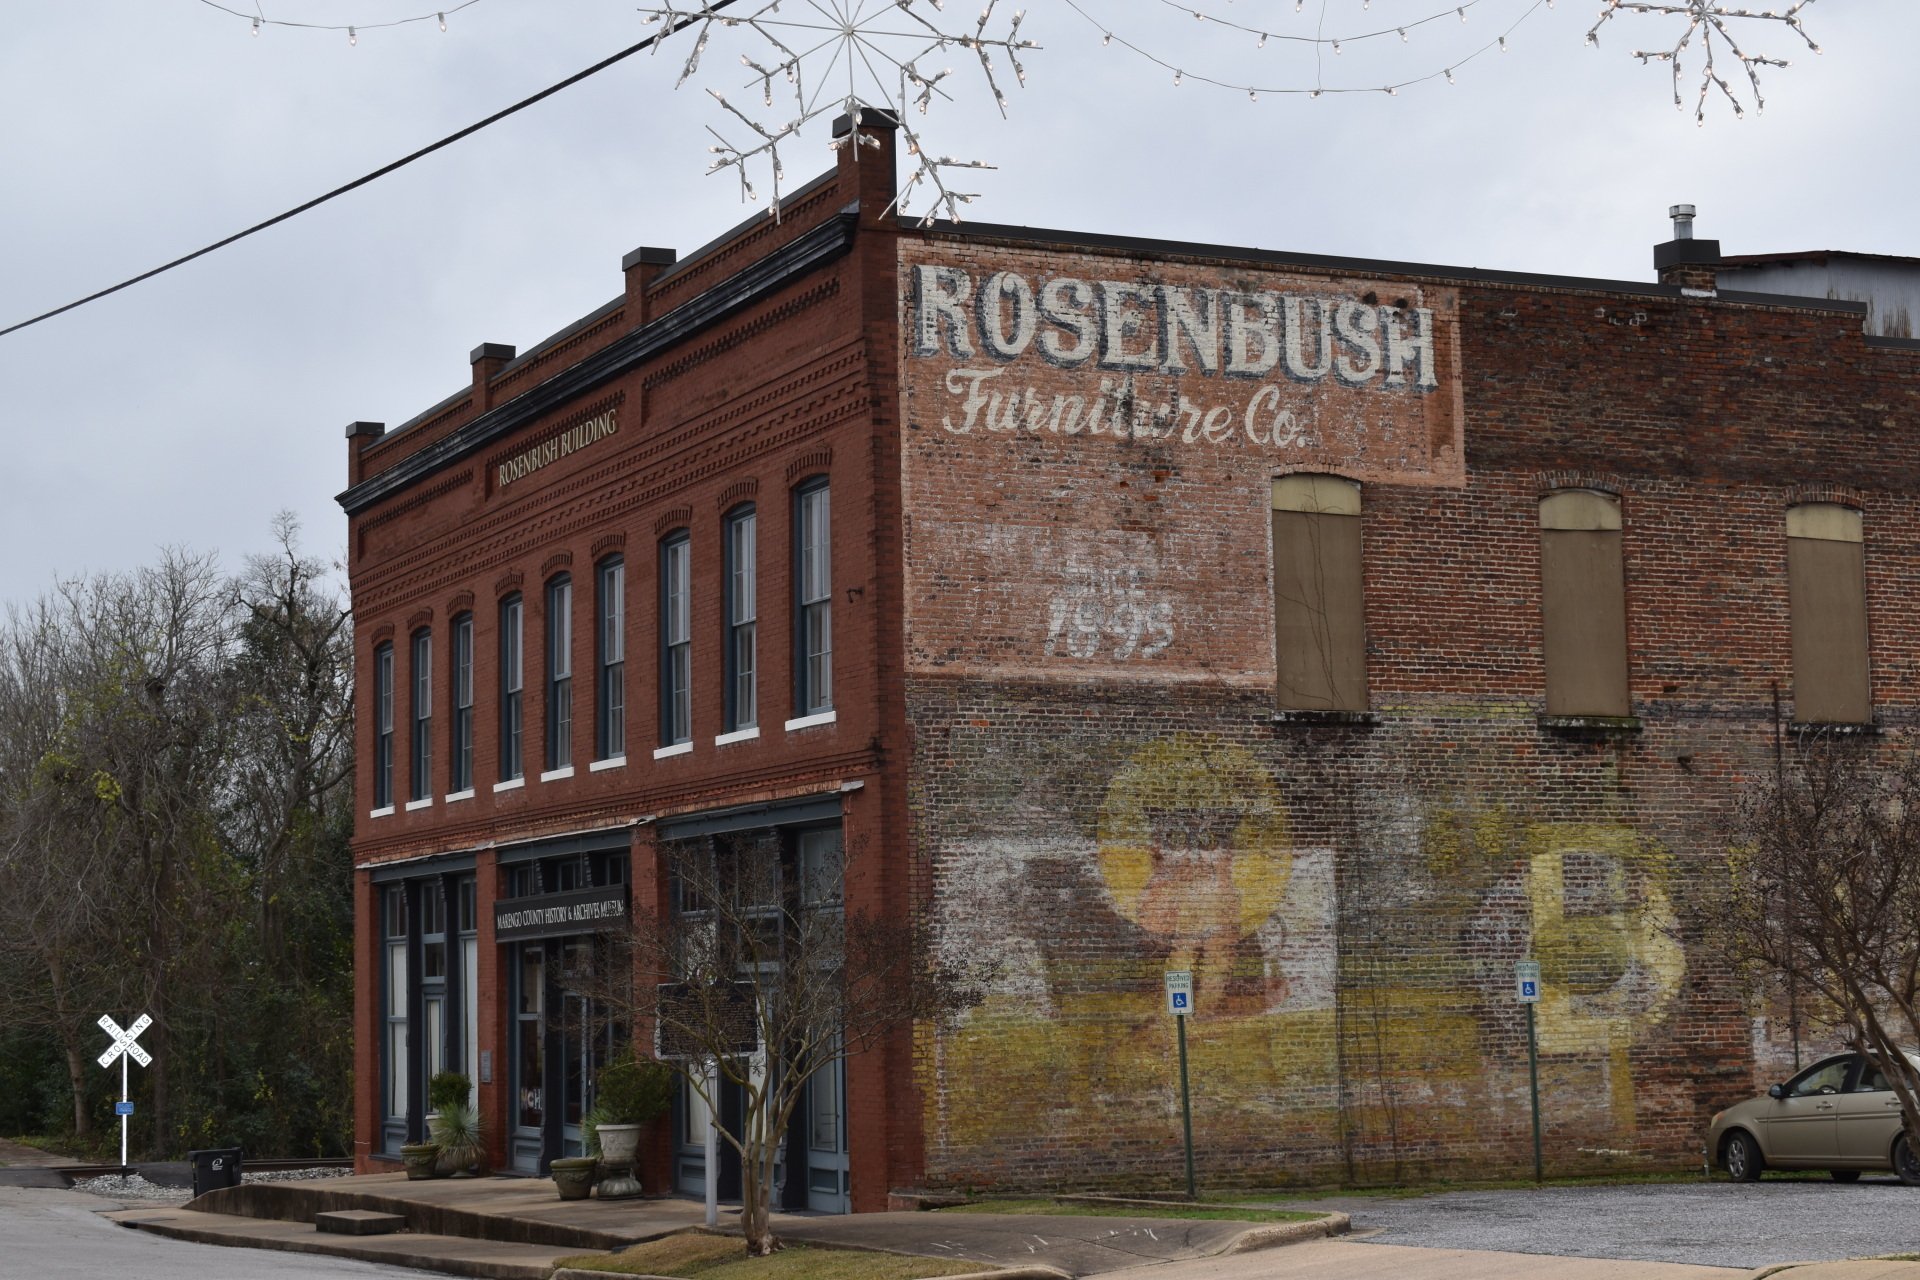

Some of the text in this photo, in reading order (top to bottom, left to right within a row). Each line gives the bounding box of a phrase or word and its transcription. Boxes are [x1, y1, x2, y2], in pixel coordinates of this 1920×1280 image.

[914, 264, 1438, 392] ROSENBUSH
[943, 366, 1306, 448] Furniture Co.
[499, 408, 616, 488] ROSENBUSH BUILDING
[1044, 599, 1174, 659] 1895
[497, 911, 522, 930] MARENGO
[523, 909, 544, 926] COUNTY
[545, 906, 568, 924] HISTORY
[568, 906, 573, 920] &
[573, 902, 600, 921] ARCHIVES
[101, 1016, 150, 1065] CROSSING
